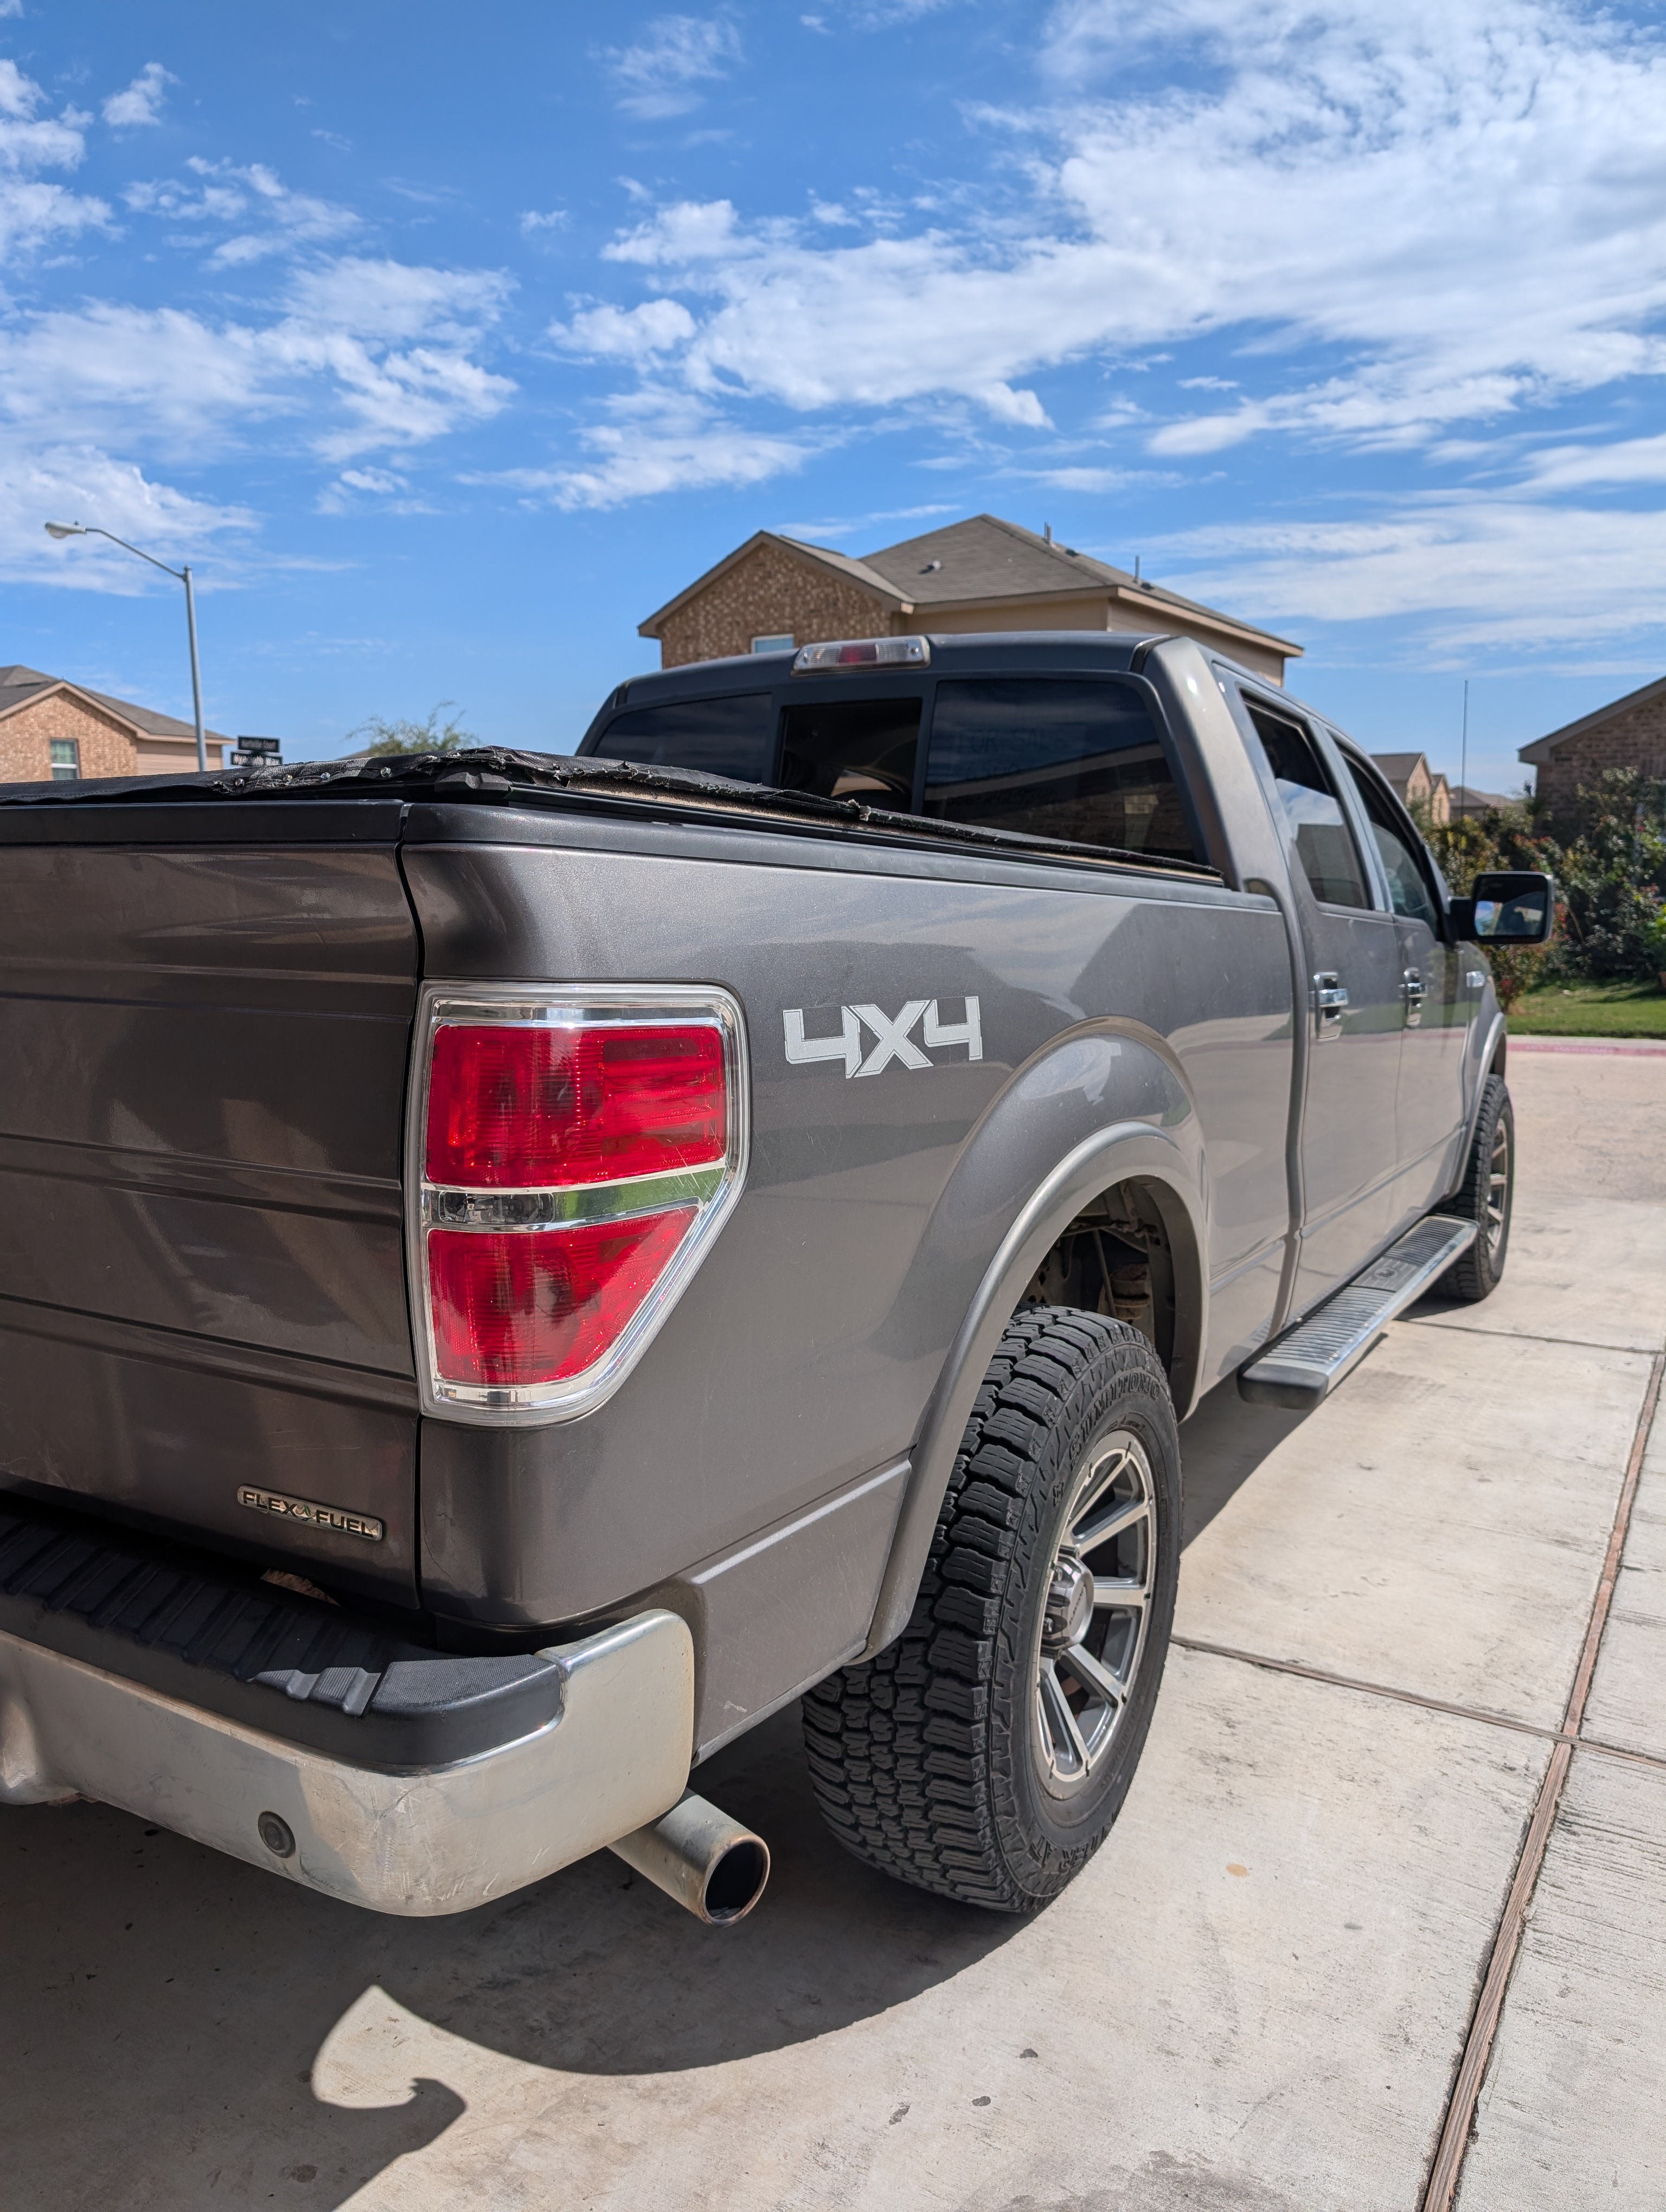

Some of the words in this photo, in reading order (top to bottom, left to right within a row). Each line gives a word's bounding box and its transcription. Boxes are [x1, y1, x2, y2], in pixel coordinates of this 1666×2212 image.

[265, 756, 280, 766] Way
[957, 728, 998, 754] FOR
[783, 996, 983, 1079] 4X4
[1069, 1372, 1159, 1471] SUMITOMO
[244, 1491, 298, 1518] FLEX
[316, 1509, 374, 1538] FUEL
